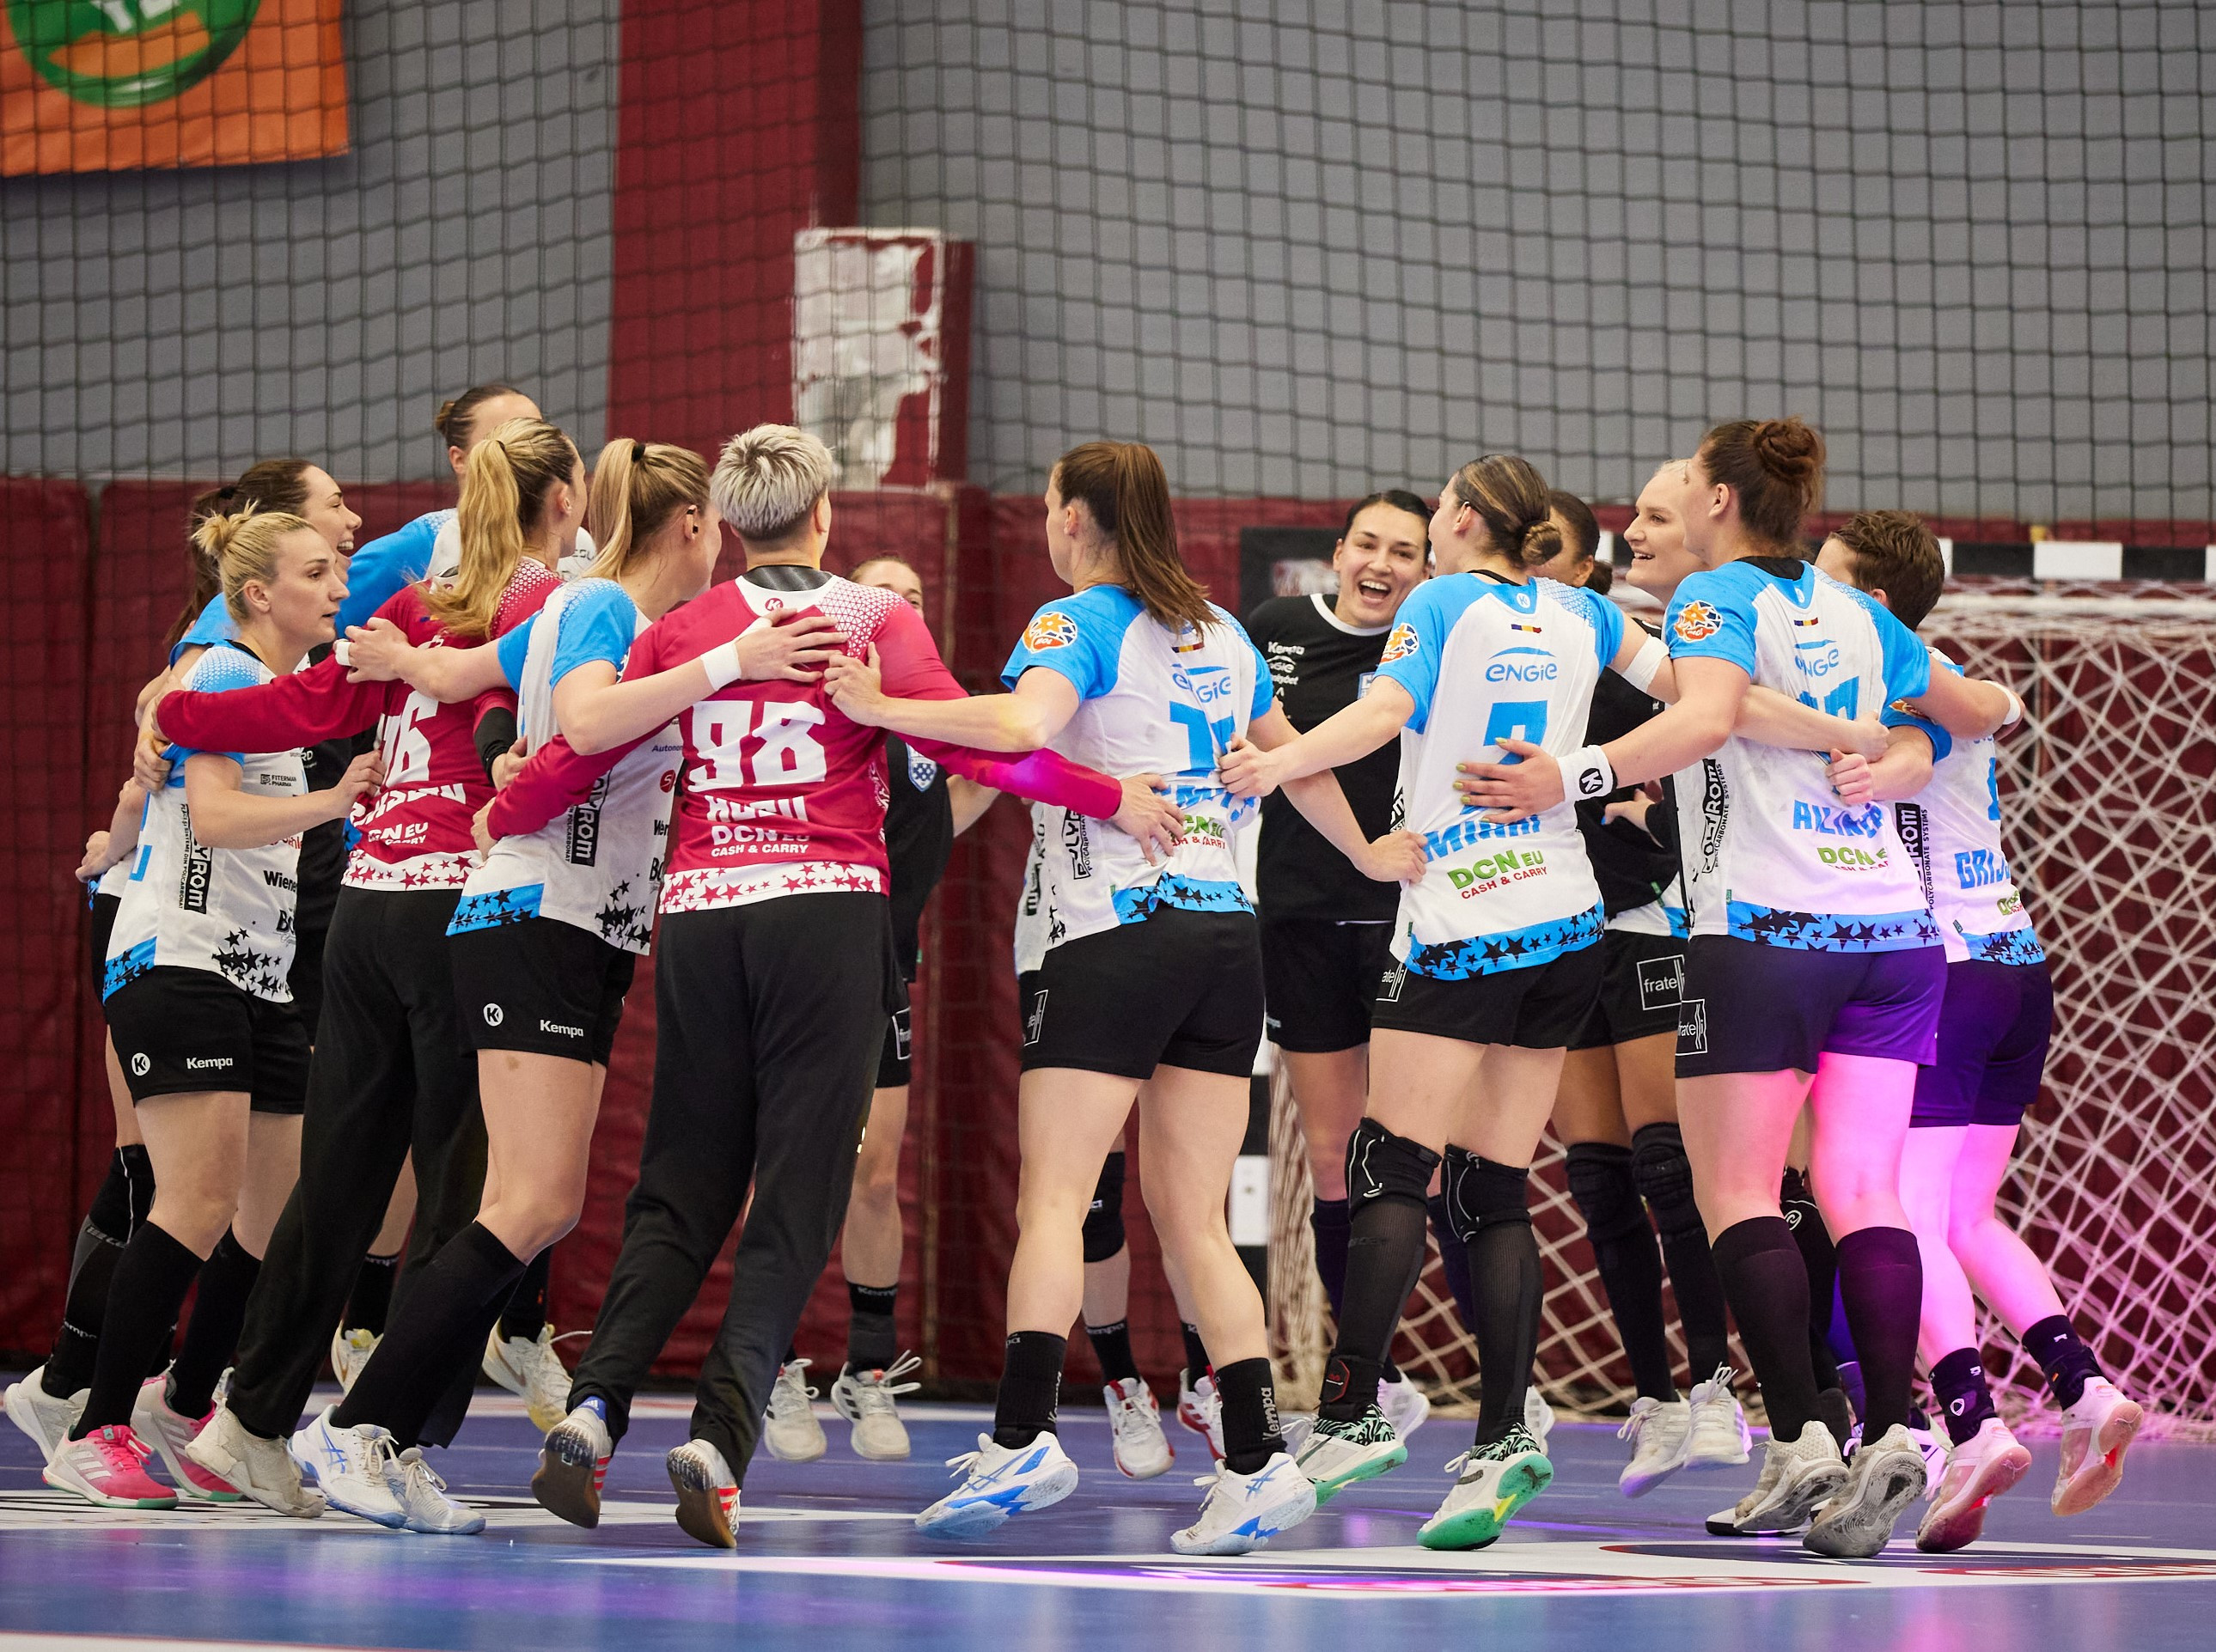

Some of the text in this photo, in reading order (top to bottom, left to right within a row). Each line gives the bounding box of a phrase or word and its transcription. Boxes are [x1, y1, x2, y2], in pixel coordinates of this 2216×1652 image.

[688, 700, 826, 792] 98
[1921, 809, 1930, 841] SYSTEMS
[711, 843, 809, 857] CASH & CARRY
[1461, 866, 1548, 899] CASH & CARRY
[540, 1020, 584, 1038] Kempa
[186, 1058, 233, 1070] Kempa
[1261, 1387, 1281, 1441] Kempa
